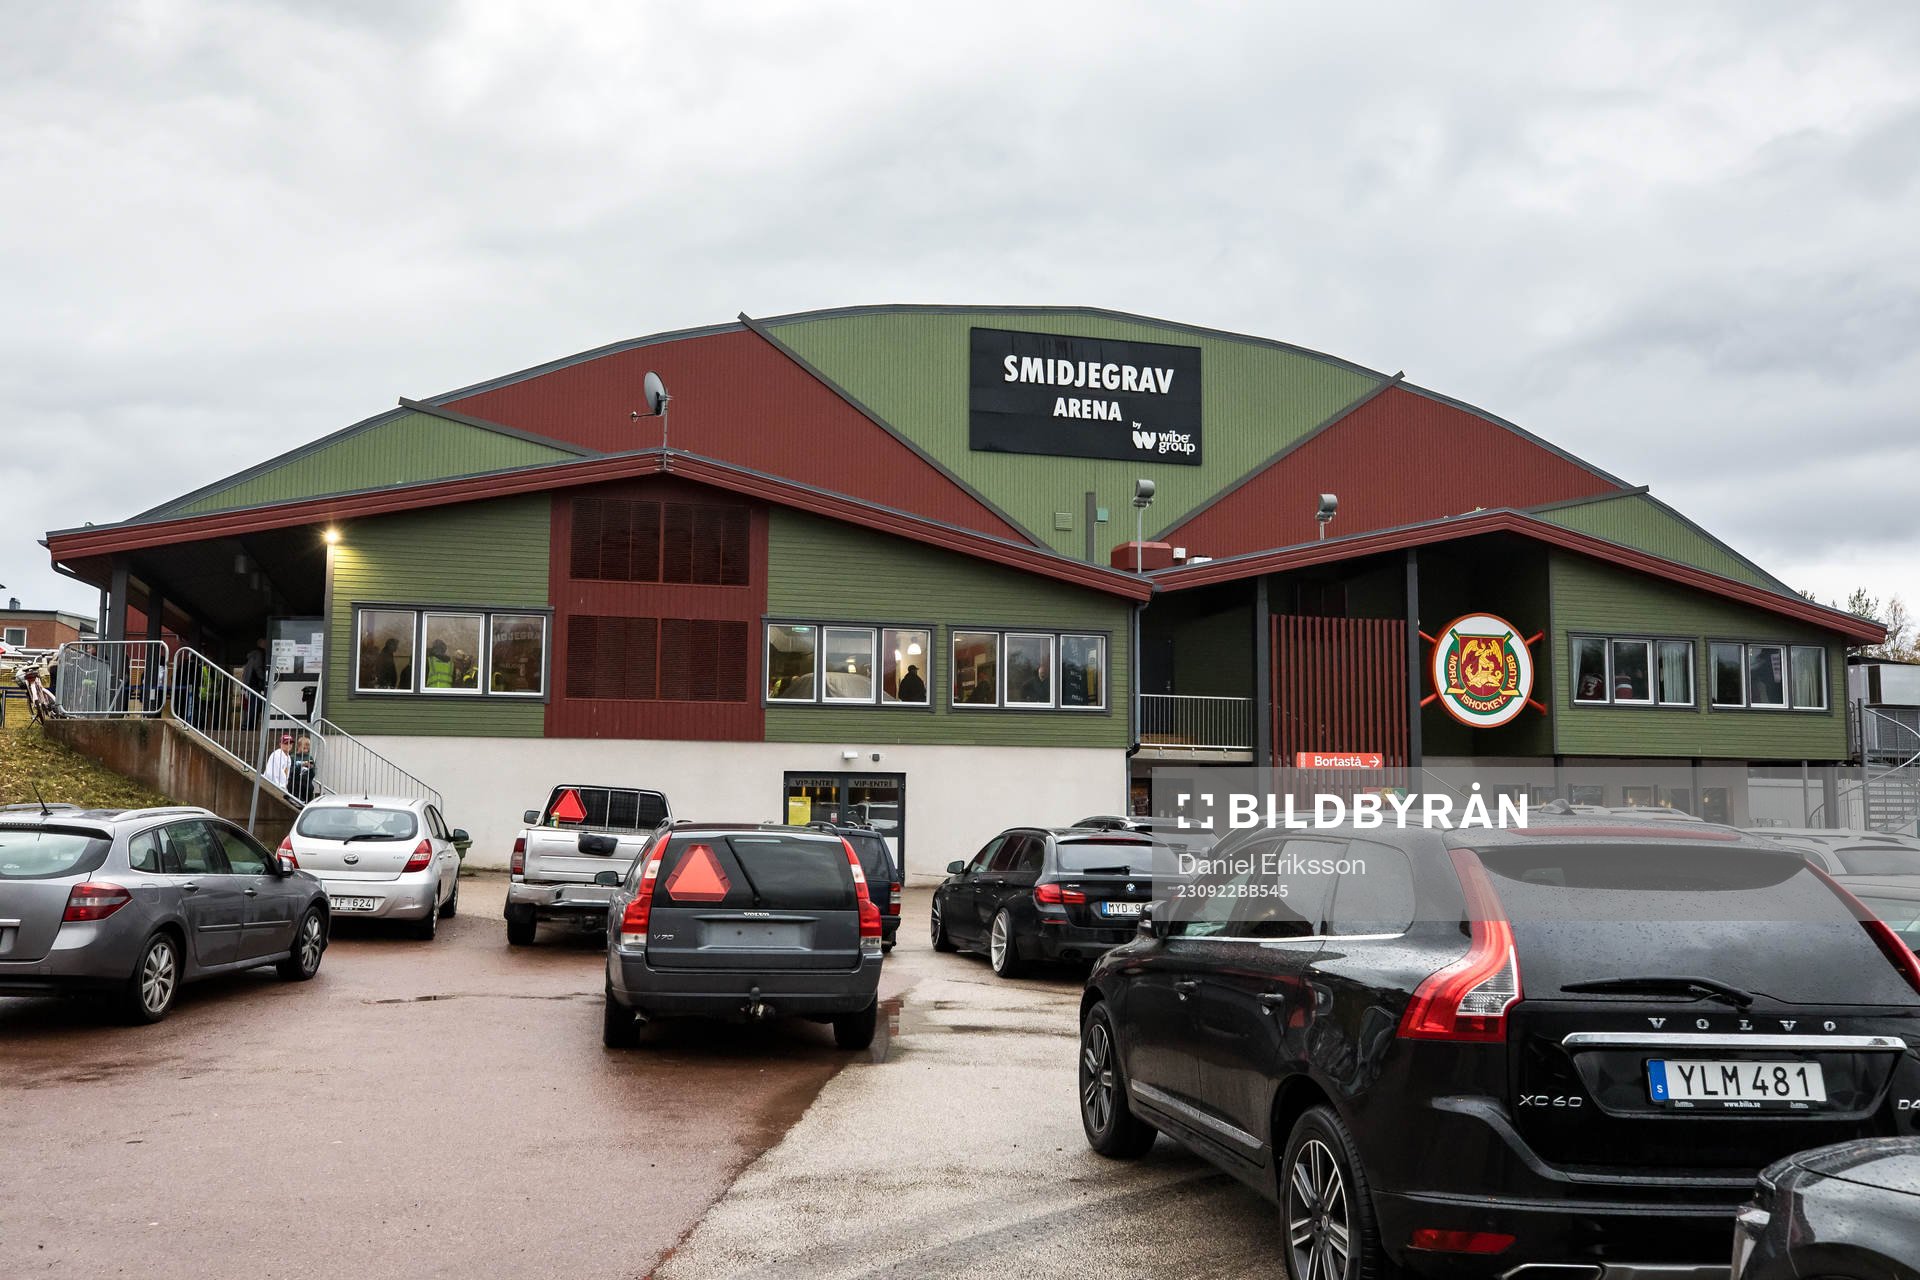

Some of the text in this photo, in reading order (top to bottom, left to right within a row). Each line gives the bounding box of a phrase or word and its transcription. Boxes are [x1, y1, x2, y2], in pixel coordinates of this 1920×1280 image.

[1004, 354, 1175, 394] SMIDJEGRAV
[1053, 397, 1123, 421] ARENA
[1132, 421, 1142, 430] by
[1158, 430, 1189, 443] wibe
[1158, 442, 1196, 456] group
[1448, 654, 1459, 686] MORA
[1505, 654, 1518, 689] KLUBB
[352, 898, 371, 909] 624
[1108, 903, 1128, 913] MYD
[1648, 1017, 1837, 1032] VOLVO
[1656, 1065, 1810, 1097] S YLM 481
